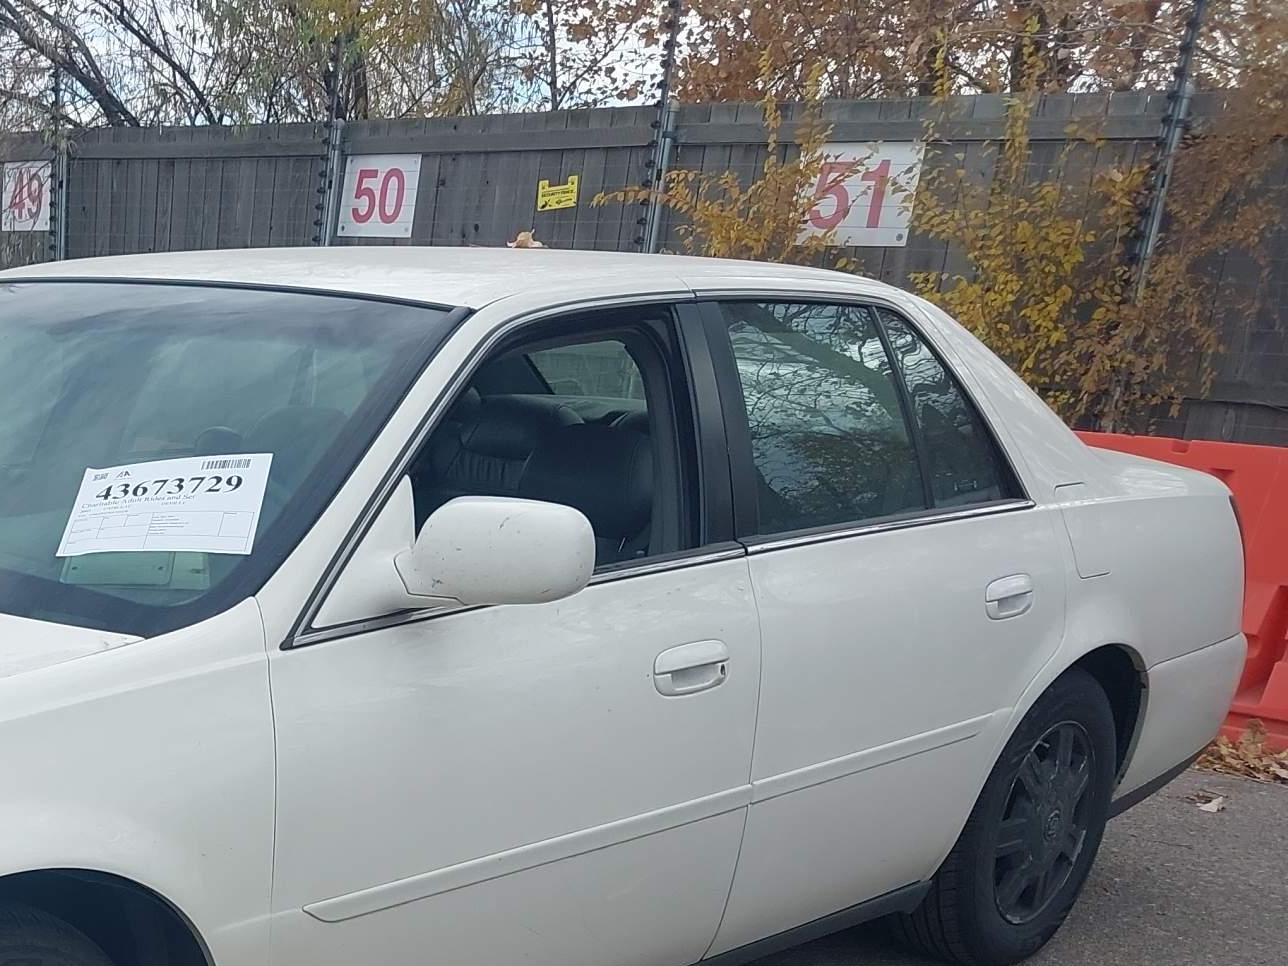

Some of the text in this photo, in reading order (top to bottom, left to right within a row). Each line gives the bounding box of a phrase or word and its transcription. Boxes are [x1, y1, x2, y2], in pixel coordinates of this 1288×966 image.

[10, 169, 43, 220] 49
[351, 167, 406, 225] 50
[810, 159, 891, 230] 51
[81, 499, 120, 509] Charitable
[123, 496, 142, 504] Adult
[96, 474, 243, 501] 43673729
